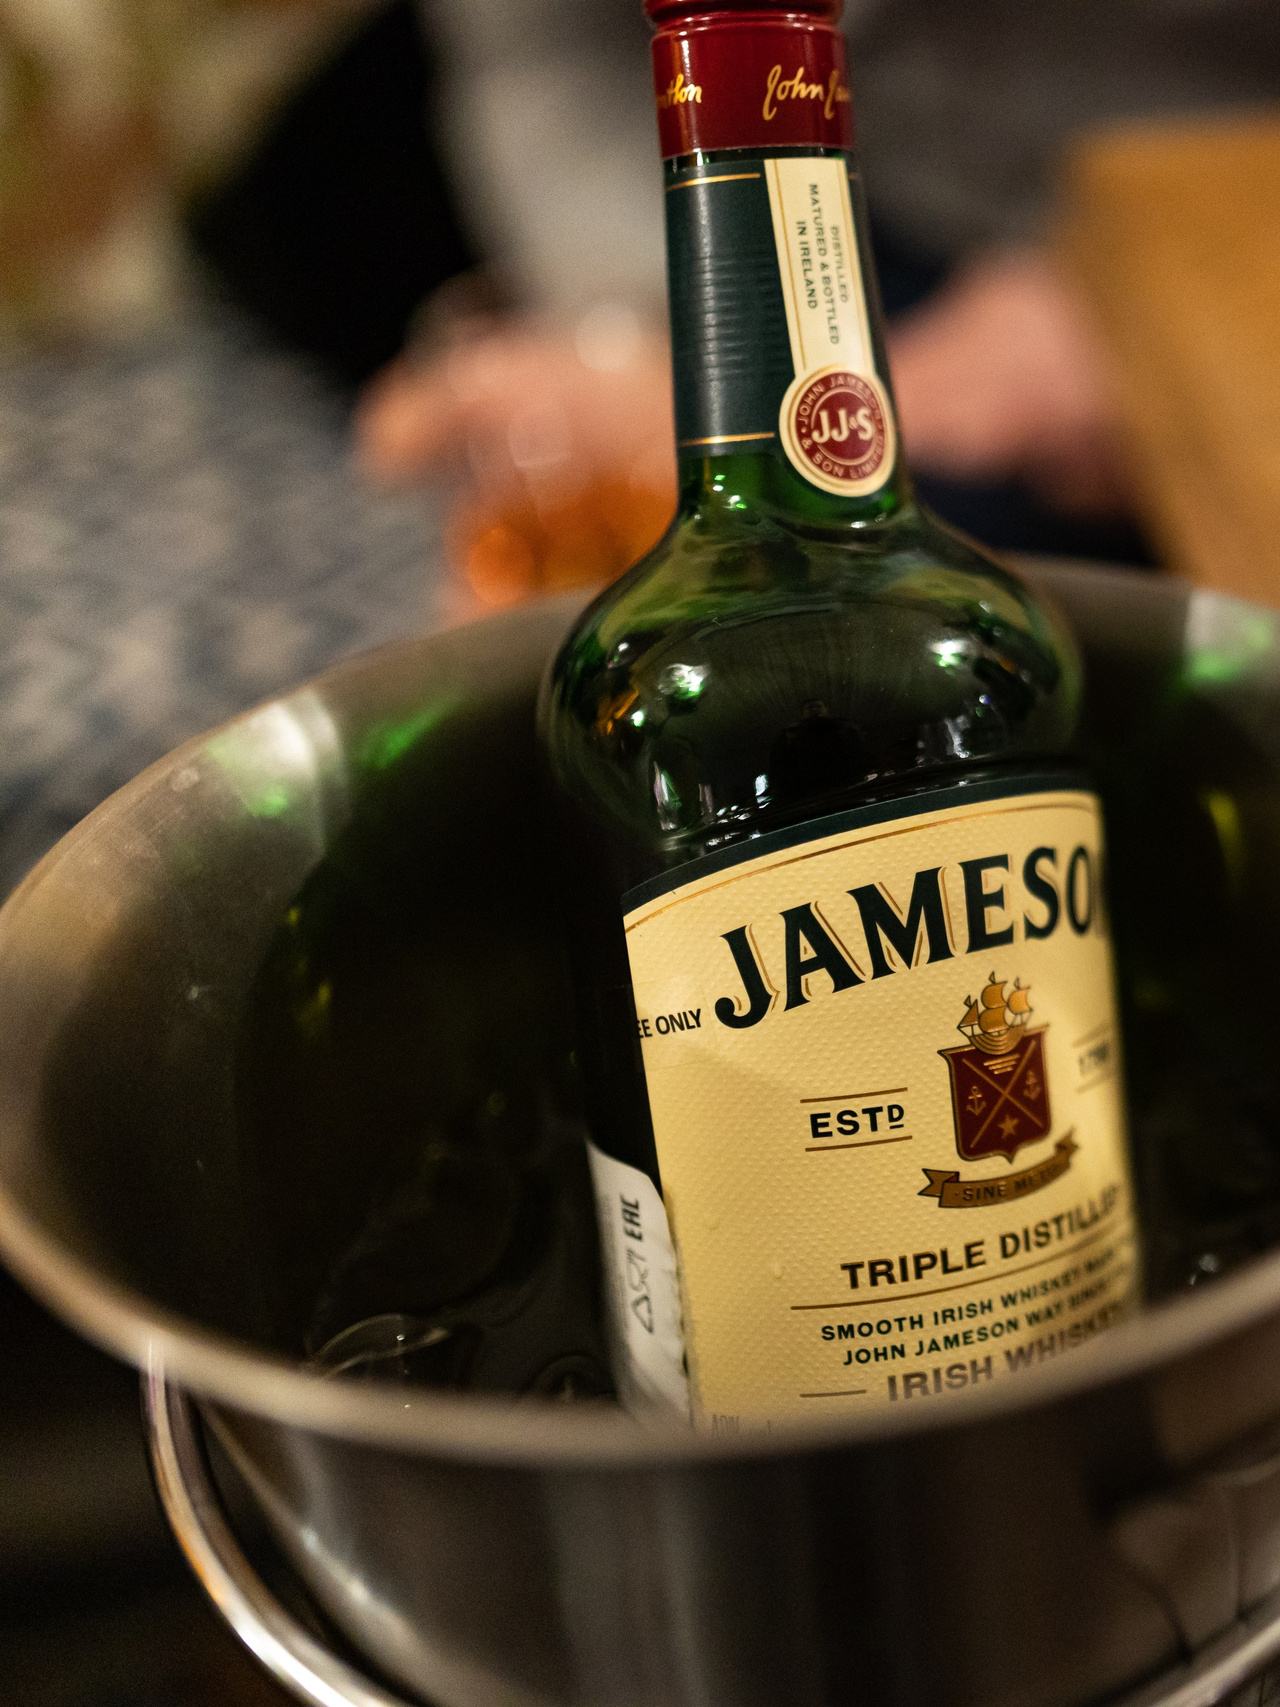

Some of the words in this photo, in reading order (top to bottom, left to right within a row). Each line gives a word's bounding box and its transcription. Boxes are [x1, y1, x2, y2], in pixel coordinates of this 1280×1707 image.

[763, 64, 824, 121] John
[796, 220, 807, 237] IN
[808, 183, 826, 257] MATURED
[798, 240, 817, 310] IRELAND
[819, 261, 829, 273] &
[830, 225, 848, 304] DISTILLED
[821, 273, 840, 345] BOTTLED
[798, 383, 825, 426] JOHN
[812, 451, 845, 478] SON
[655, 1008, 702, 1036] ONLY
[962, 1183, 1008, 1202] SINE
[841, 1239, 986, 1290] TRIPLE
[820, 1313, 924, 1341] SMOOTH
[933, 1302, 993, 1326] IRISH
[842, 1343, 906, 1367] JOHN
[914, 1317, 1019, 1357] JAMESON
[886, 1355, 993, 1402] IRISH
